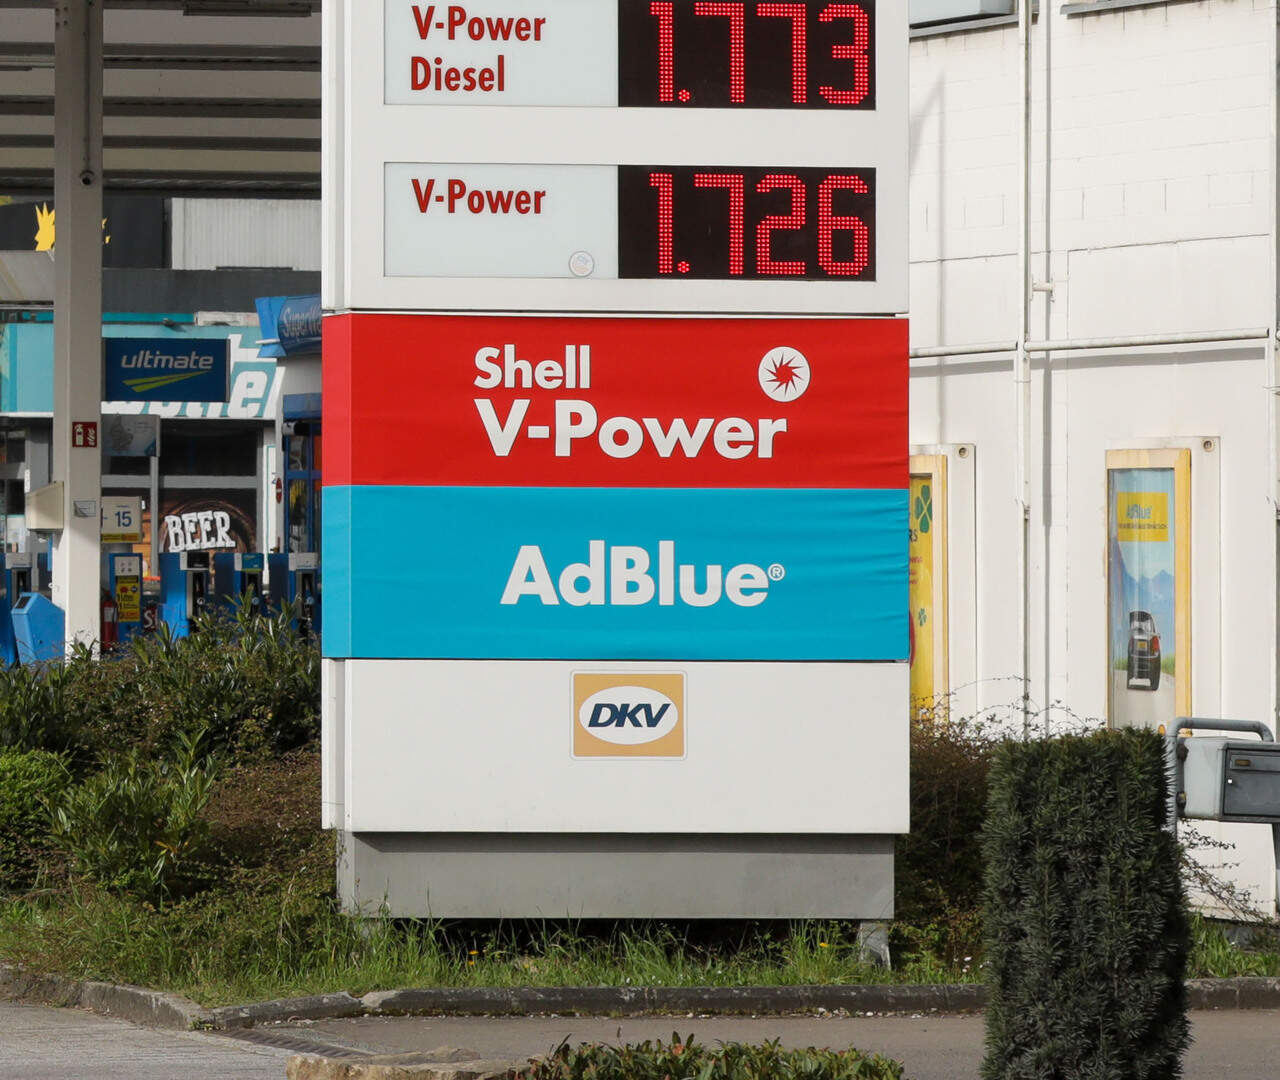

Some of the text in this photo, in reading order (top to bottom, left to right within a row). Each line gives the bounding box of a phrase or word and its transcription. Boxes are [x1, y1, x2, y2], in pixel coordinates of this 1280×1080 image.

[410, 54, 506, 93] Diesel
[411, 1, 869, 105] V-Power 1.773
[411, 172, 869, 276] V-Power 1.726
[121, 350, 214, 369] ultimate
[473, 344, 591, 390] Shell
[473, 398, 788, 460] V-Power
[114, 511, 132, 528] 15
[164, 510, 236, 554] BEER
[588, 702, 672, 728] DKV
